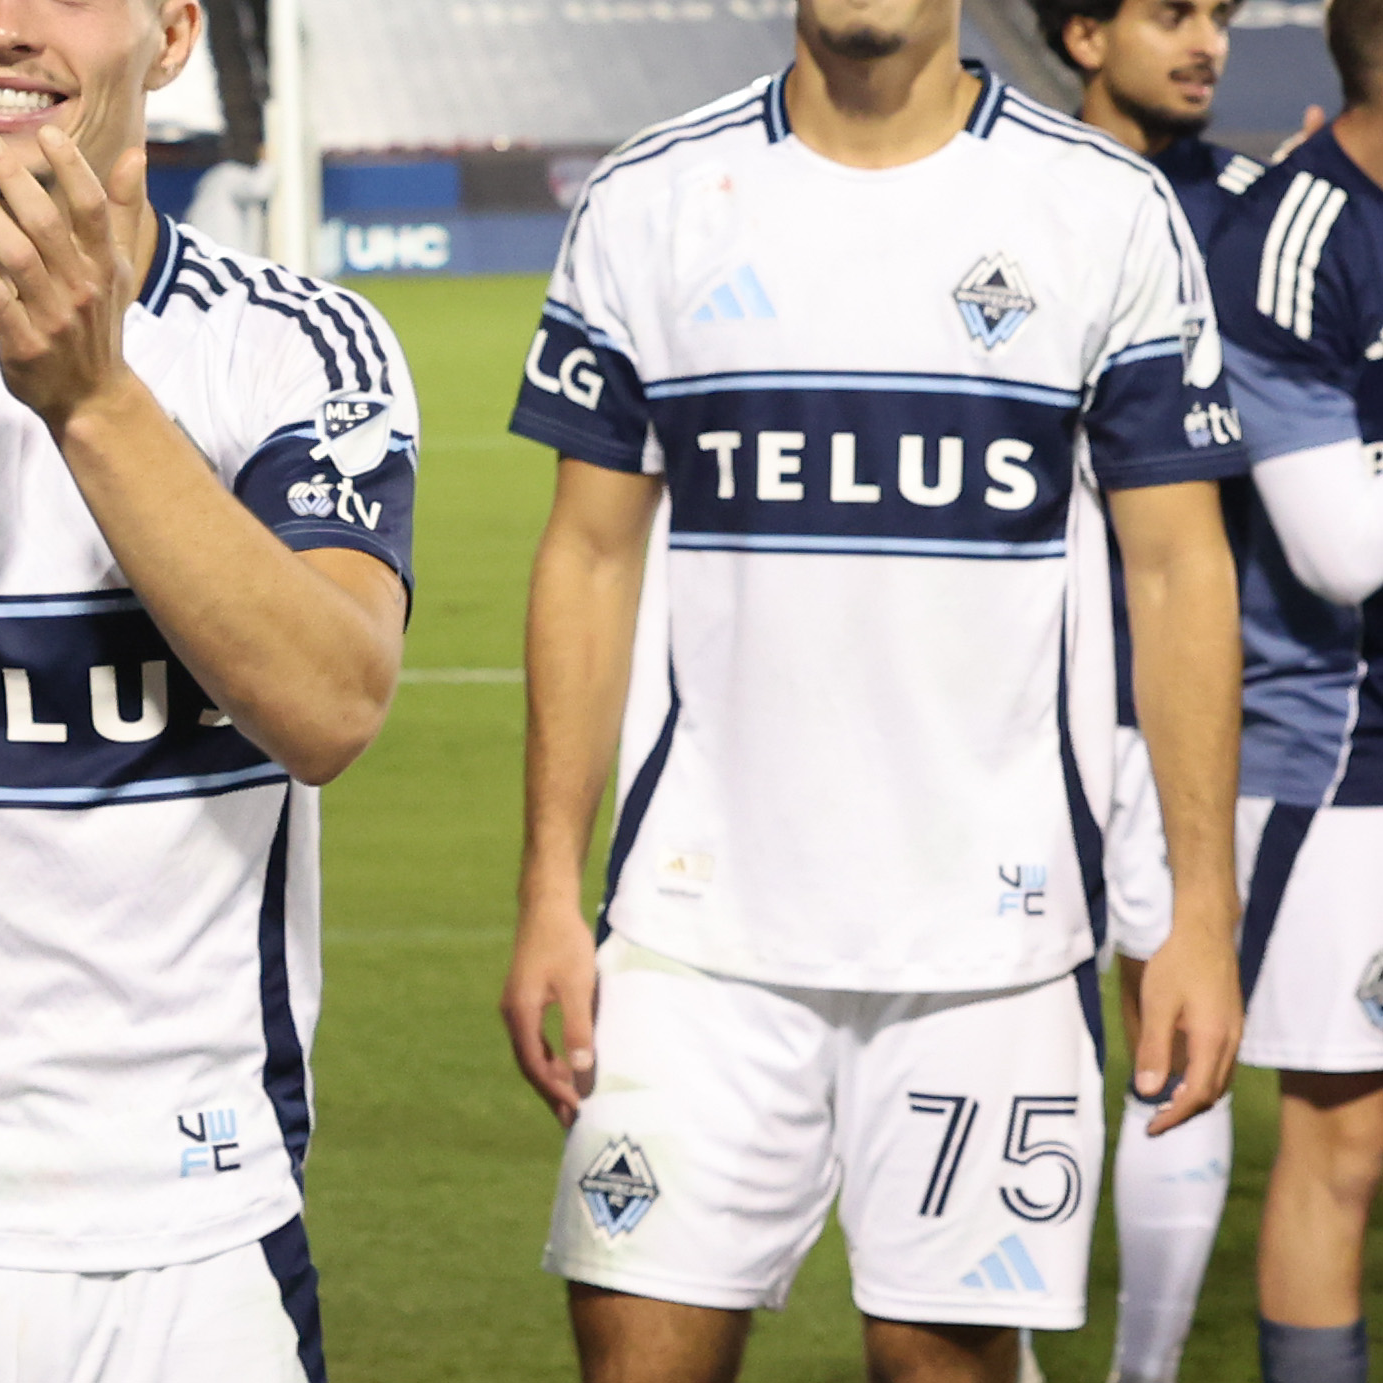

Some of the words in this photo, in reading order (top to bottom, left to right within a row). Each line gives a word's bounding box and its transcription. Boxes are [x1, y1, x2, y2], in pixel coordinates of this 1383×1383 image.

[346, 223, 451, 271] UHC
[525, 328, 605, 411] LG
[326, 403, 370, 421] MLS
[337, 477, 382, 531] tv
[697, 431, 1038, 511] TELUS
[908, 1091, 1084, 1223] 75
